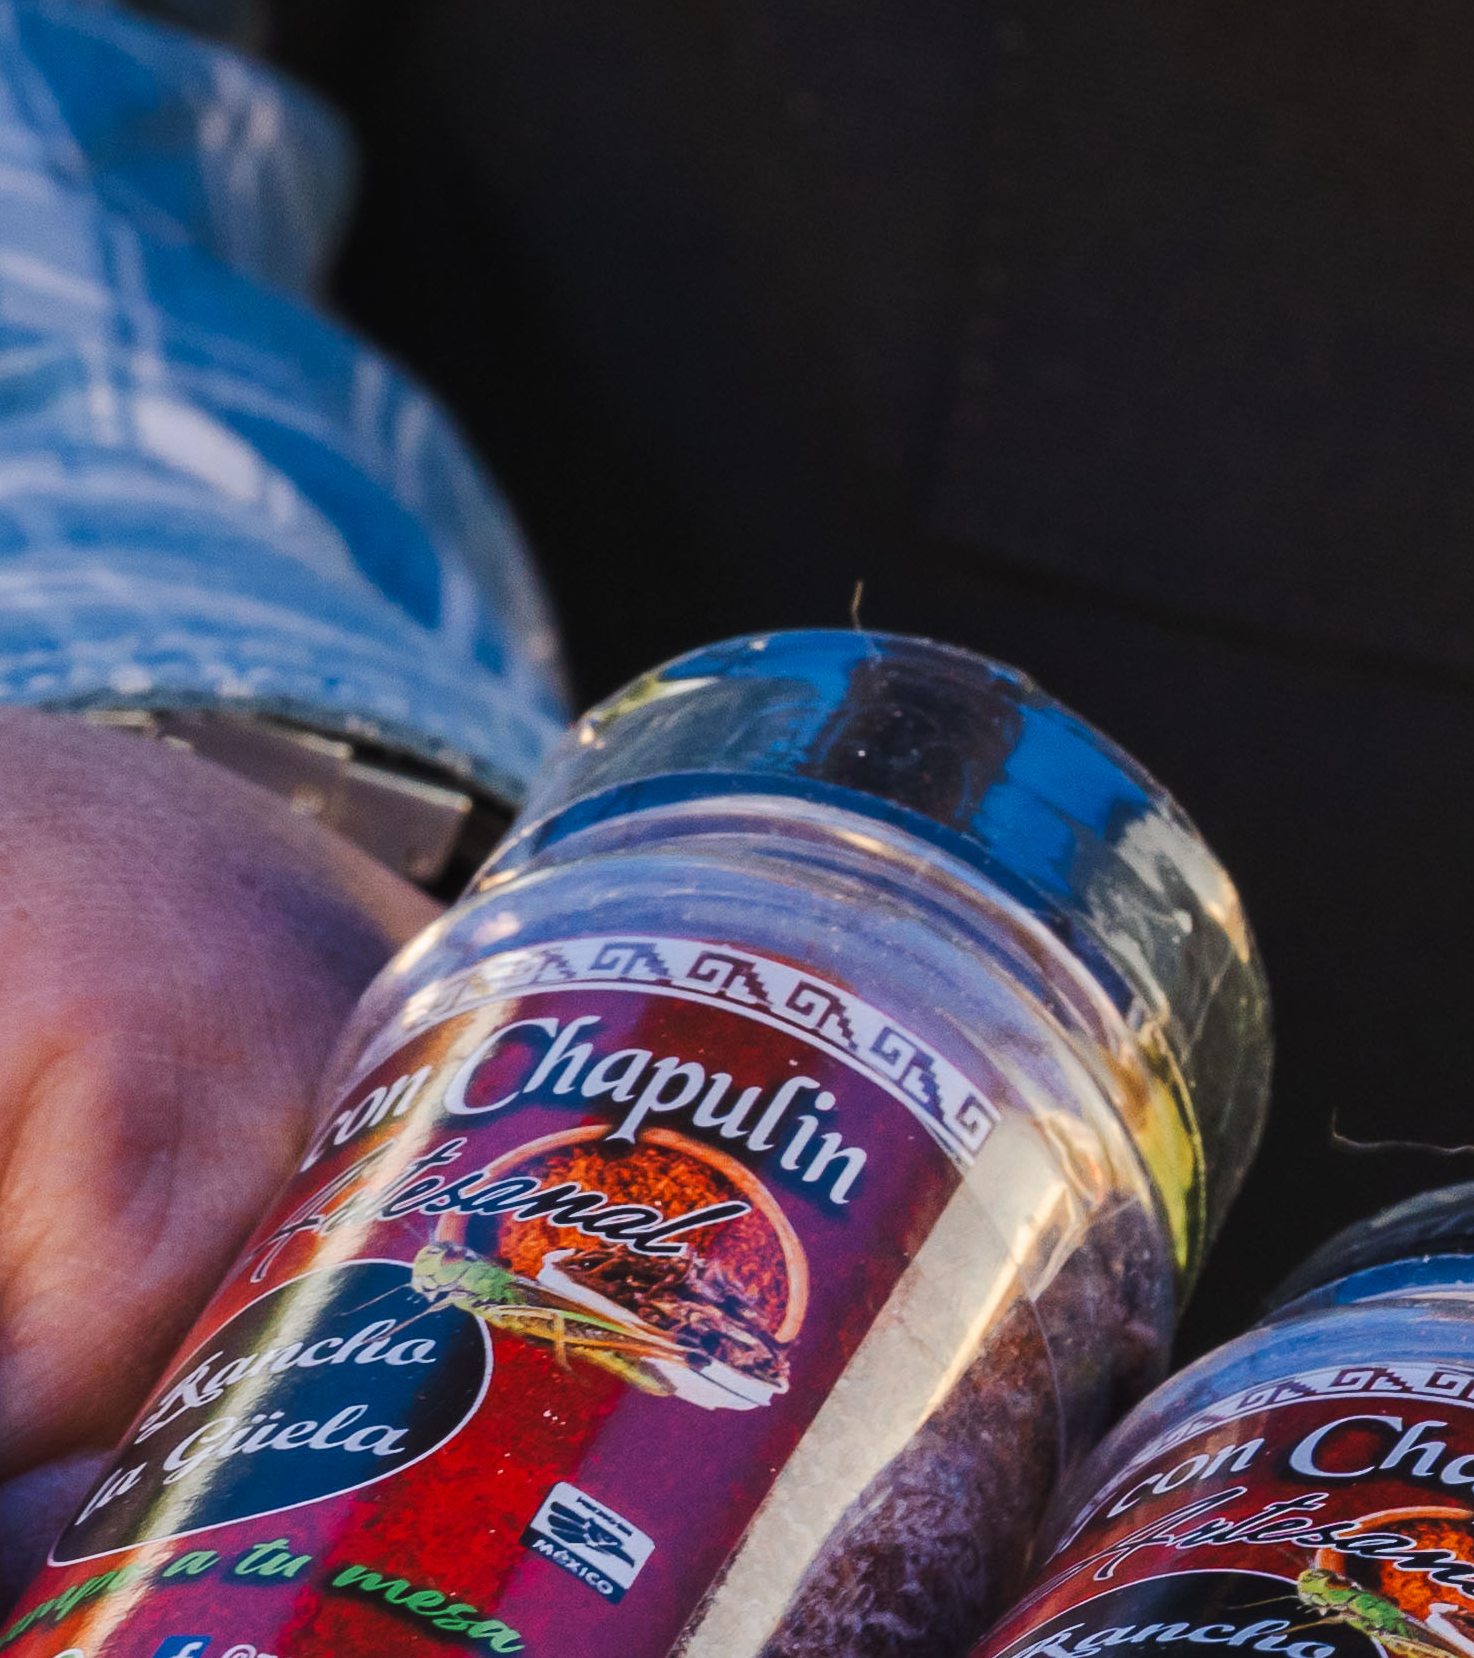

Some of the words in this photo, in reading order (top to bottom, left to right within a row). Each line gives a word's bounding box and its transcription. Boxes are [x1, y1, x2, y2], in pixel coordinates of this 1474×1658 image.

[300, 1064, 433, 1174] con
[443, 1015, 868, 1205] Chapulin
[134, 1318, 437, 1444] Rancho
[162, 1405, 411, 1485] Güela
[1106, 1437, 1265, 1518] con
[162, 1549, 223, 1579] a
[233, 1538, 314, 1580] tu
[330, 1562, 526, 1654] mesa
